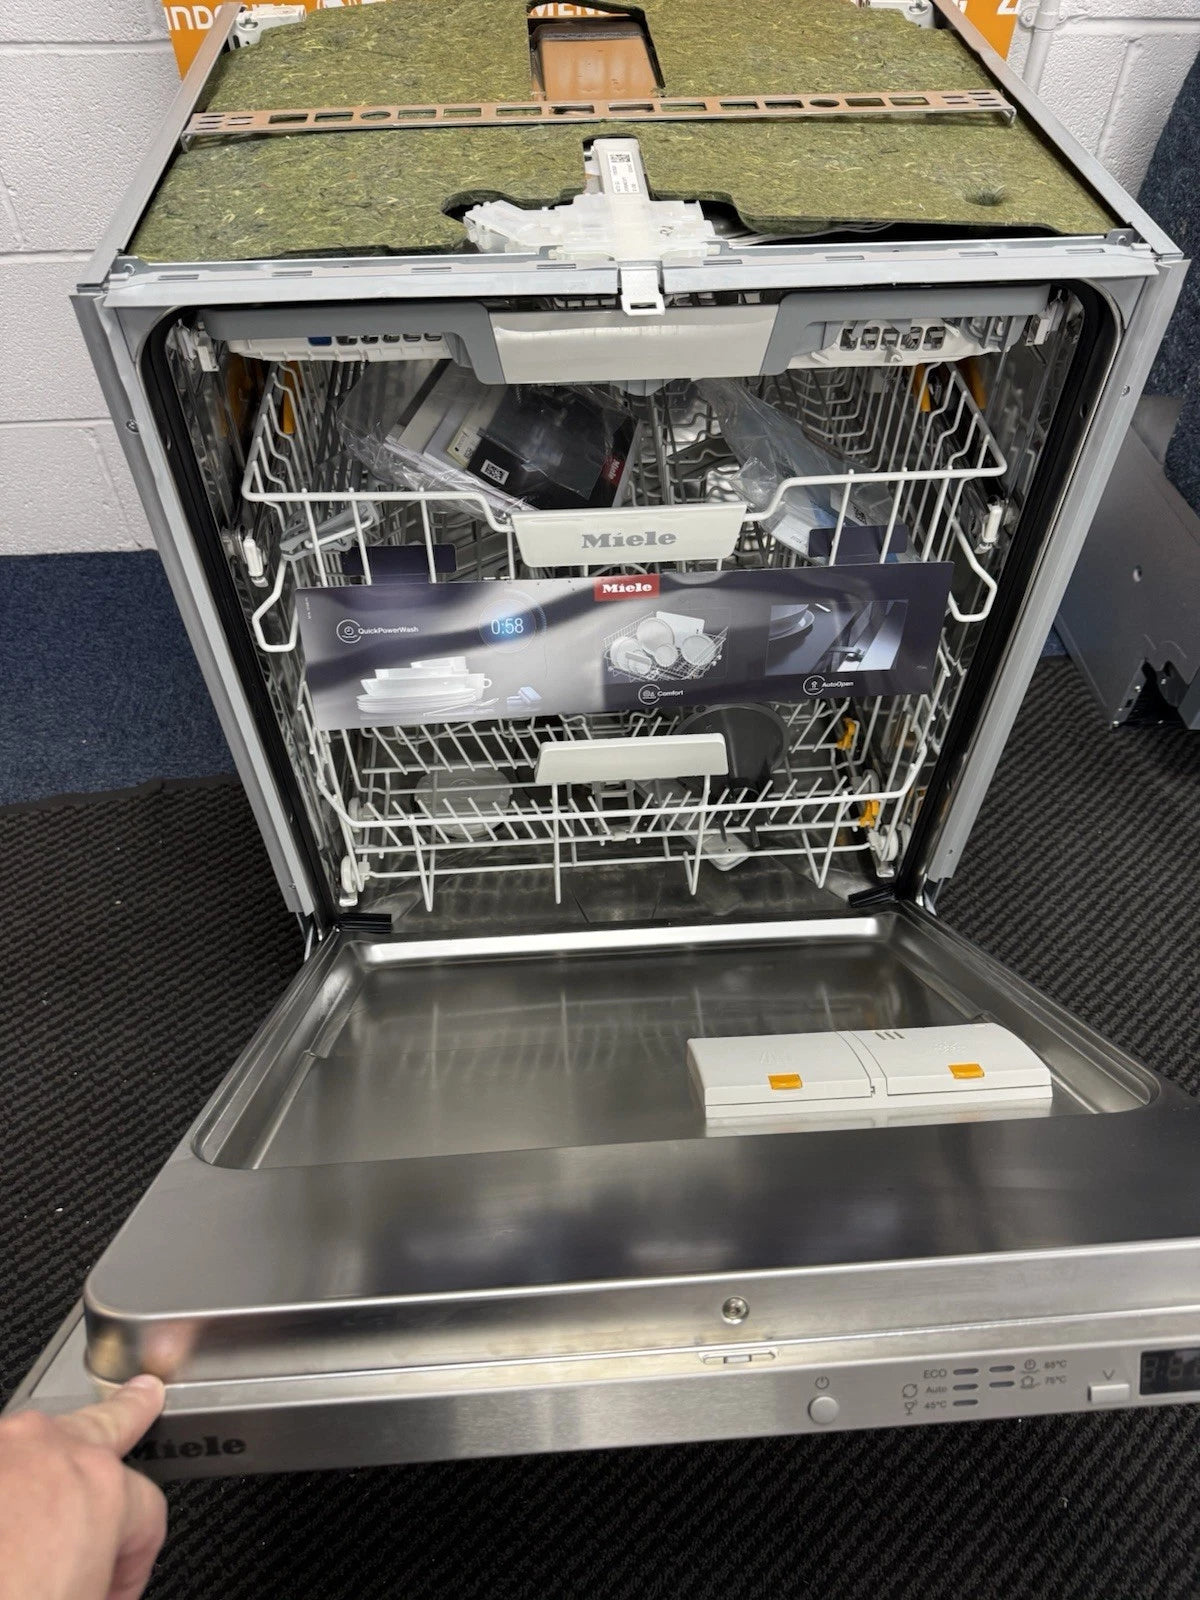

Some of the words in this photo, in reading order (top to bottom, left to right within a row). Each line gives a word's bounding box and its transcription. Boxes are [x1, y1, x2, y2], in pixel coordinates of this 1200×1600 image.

[581, 531, 677, 549] Miele
[602, 581, 653, 594] Miele
[357, 626, 419, 636] QuickPowerWash
[490, 617, 524, 635] 0:58
[821, 681, 854, 689] AutoOpen
[657, 690, 683, 698] Comfort
[923, 1368, 947, 1379] ECO
[925, 1386, 947, 1394] Auto
